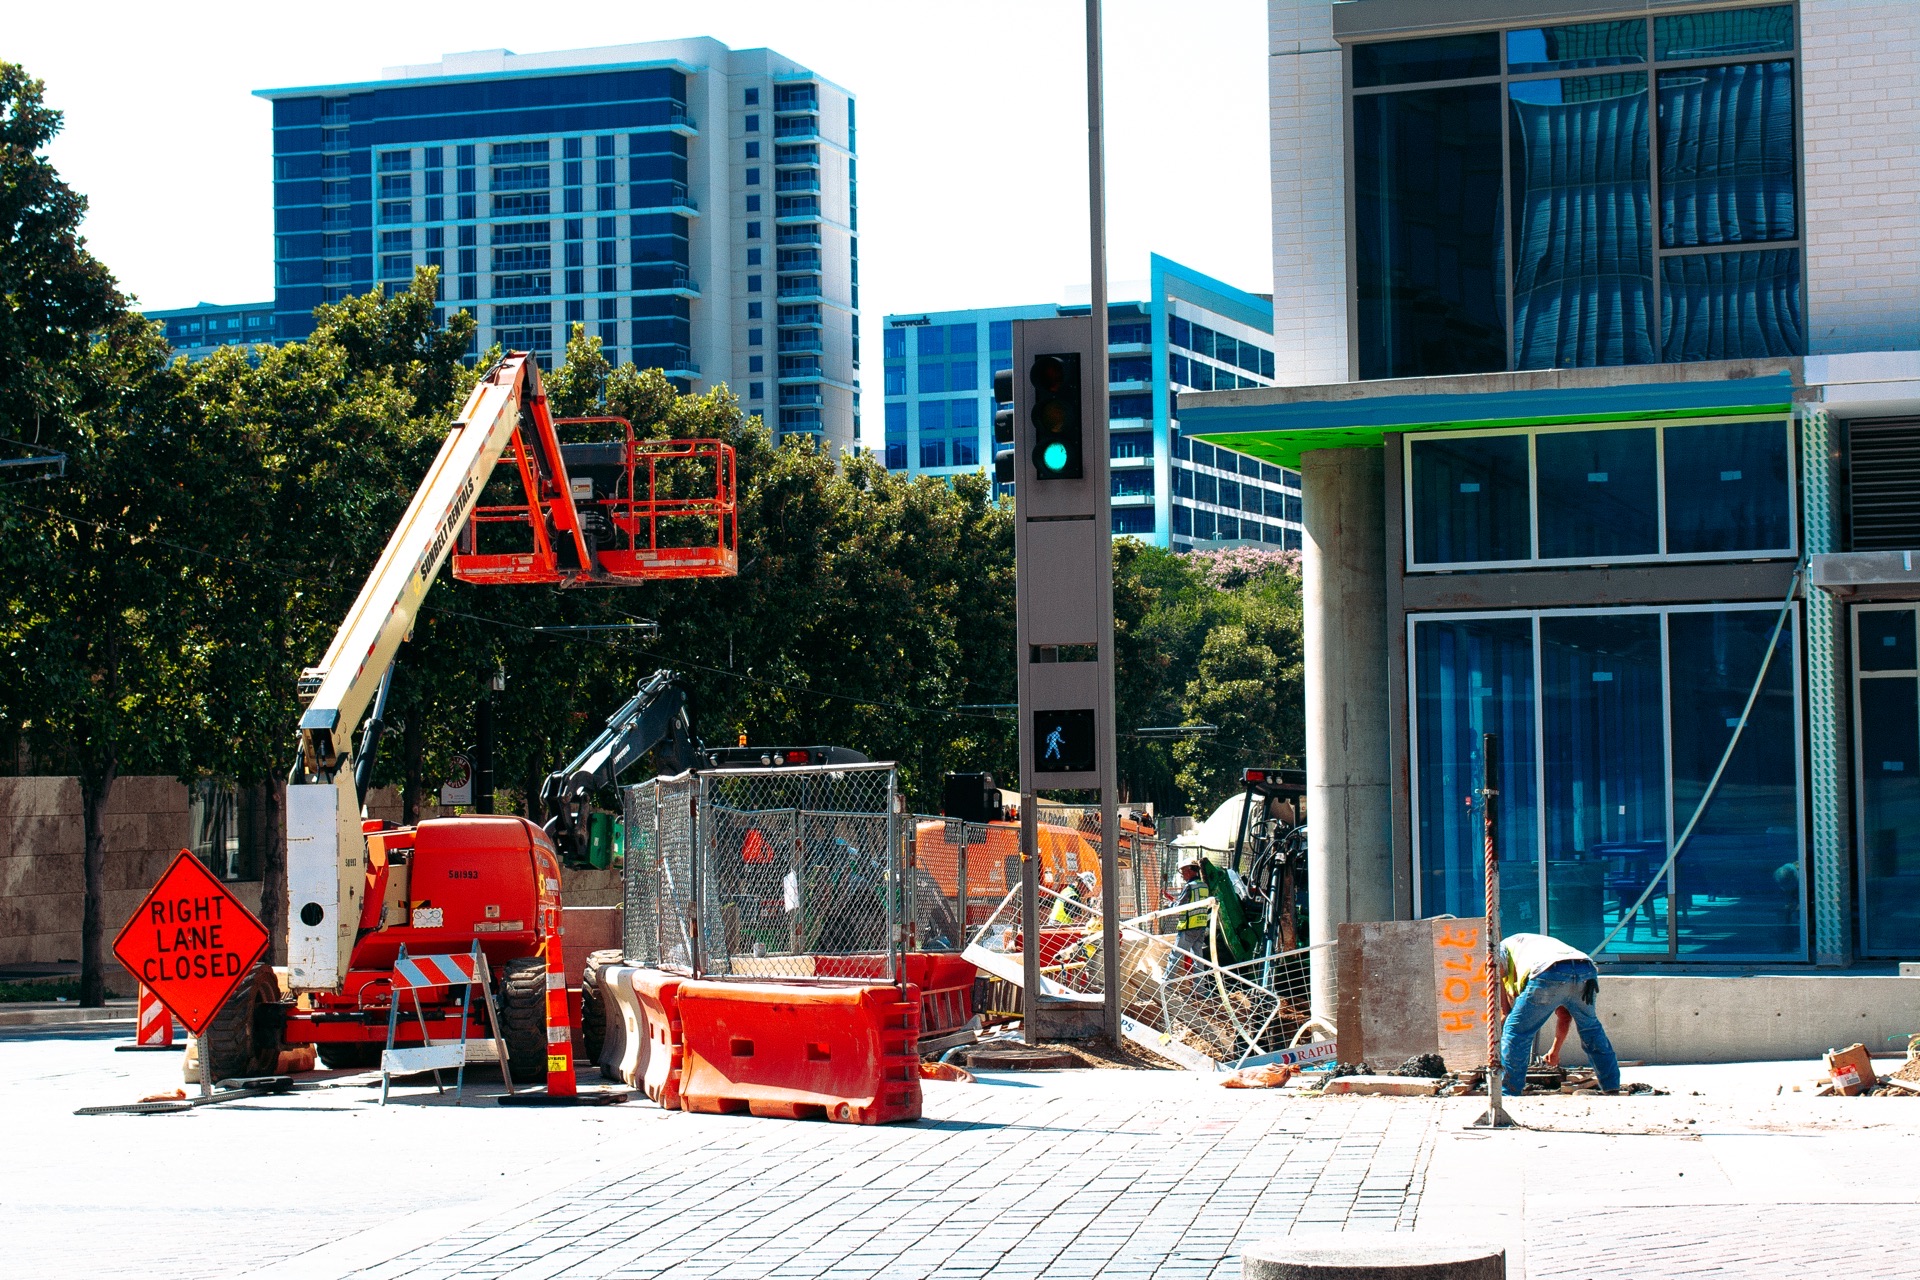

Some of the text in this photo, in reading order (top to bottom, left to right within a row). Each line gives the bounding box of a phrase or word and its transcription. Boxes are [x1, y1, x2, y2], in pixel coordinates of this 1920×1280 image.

[420, 477, 474, 582] SUNBELT RENTALS
[448, 870, 479, 879] 581993
[151, 895, 225, 925] RIGHT
[156, 925, 224, 953] LANE
[143, 952, 241, 983] CLOSED
[1440, 924, 1478, 1033] HOLE
